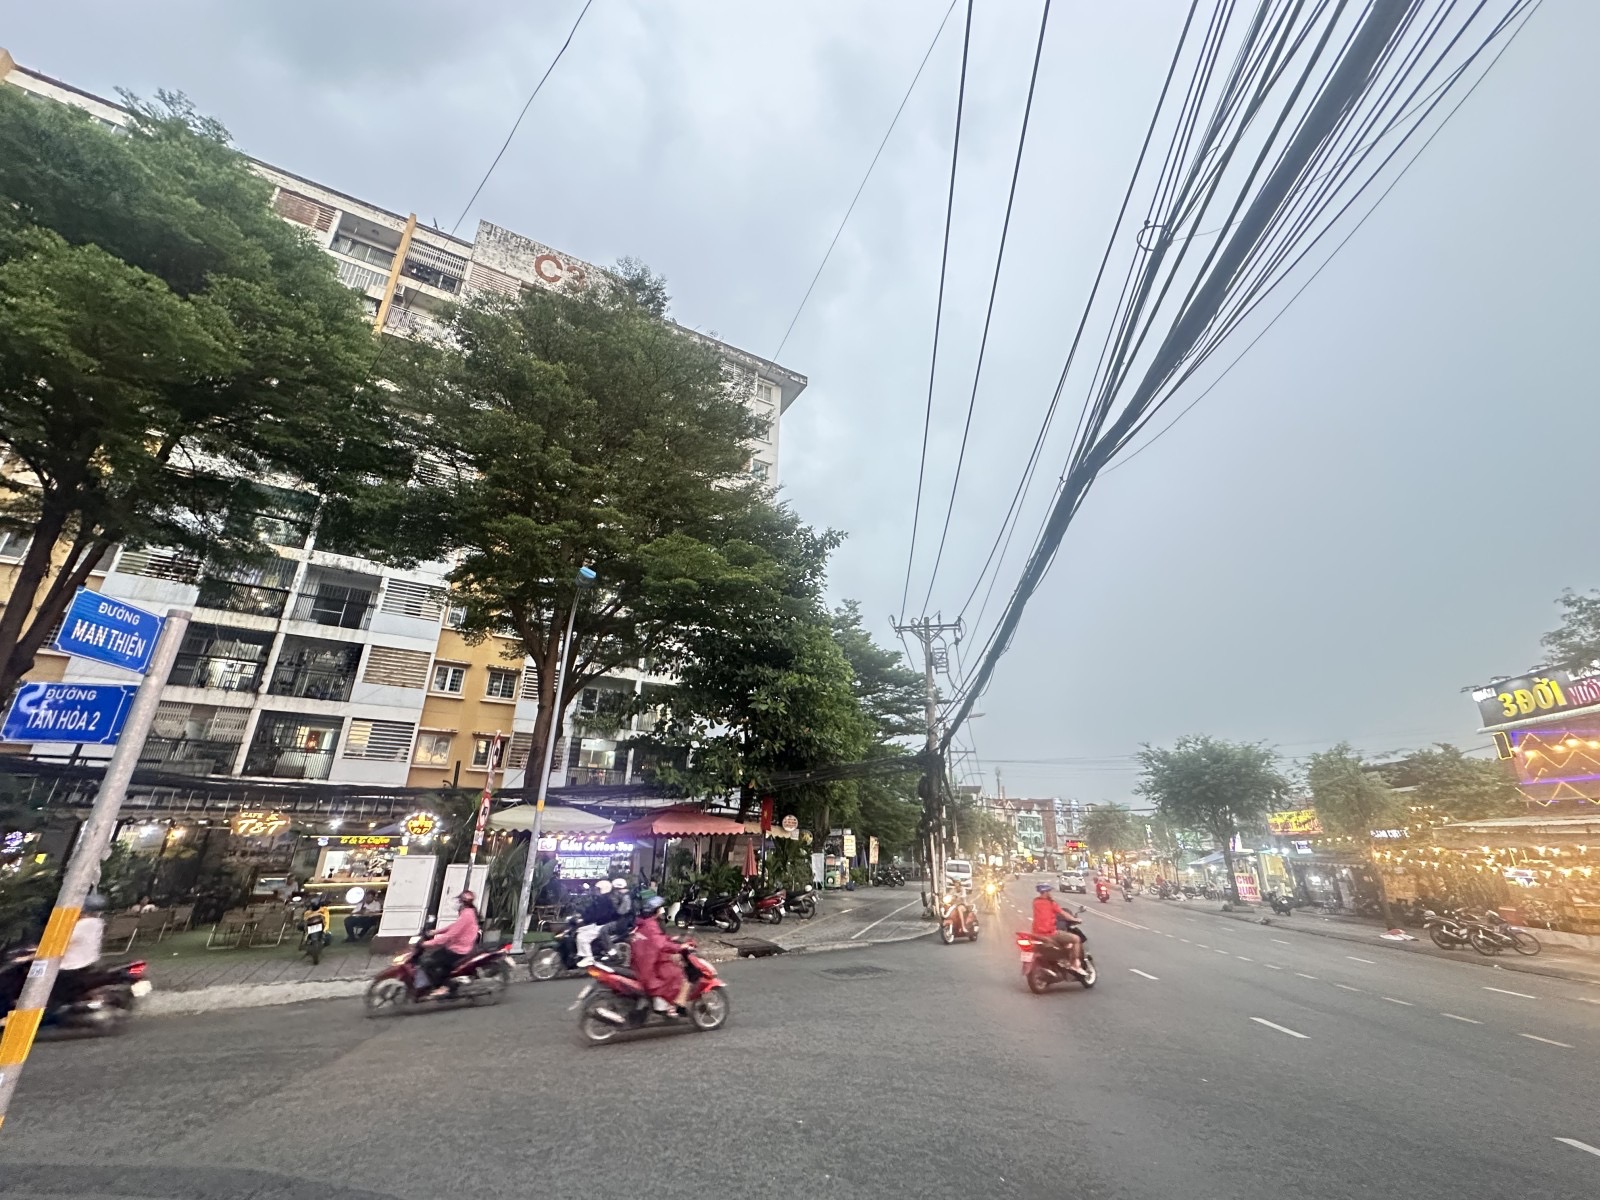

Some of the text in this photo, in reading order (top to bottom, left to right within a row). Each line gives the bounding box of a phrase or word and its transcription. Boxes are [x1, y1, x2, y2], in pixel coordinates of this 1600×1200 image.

[98, 602, 140, 625] ĐƯỜNG
[71, 618, 147, 661] MAN THIỆN
[45, 687, 97, 701] ĐƯỜNG
[56, 704, 88, 730] HÒA
[88, 711, 100, 731] 2
